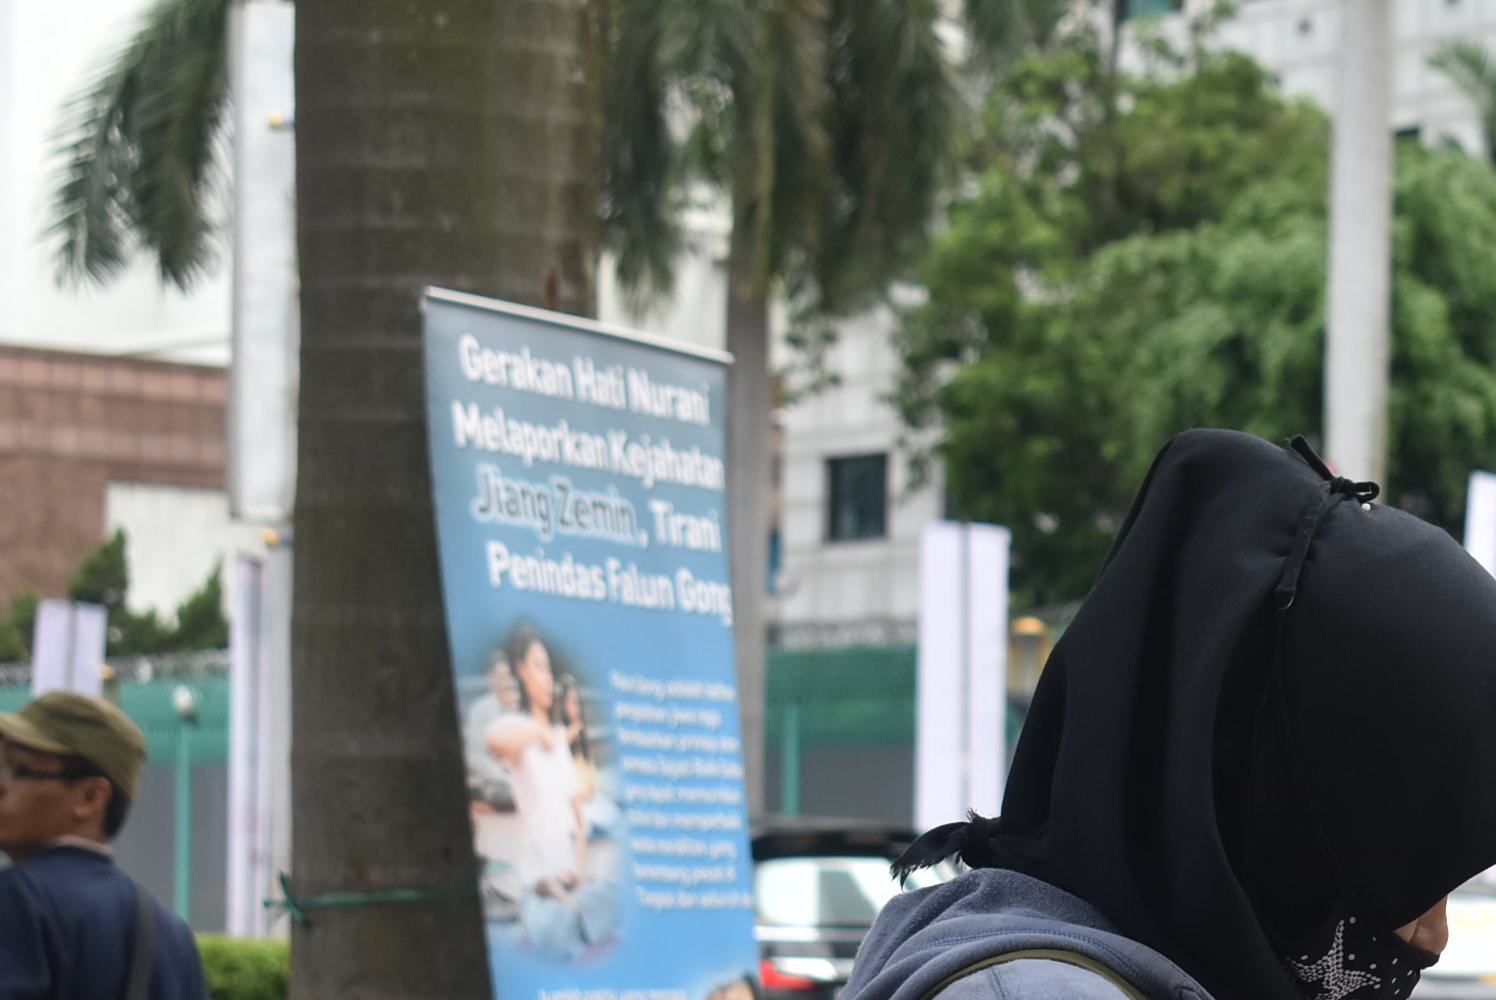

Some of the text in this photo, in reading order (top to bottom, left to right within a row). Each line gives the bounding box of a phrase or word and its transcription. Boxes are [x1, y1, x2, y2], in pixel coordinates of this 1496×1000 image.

[458, 333, 711, 425] Gerakan Hati Nurani
[451, 399, 726, 489] Melaporkan Kejahatan
[470, 463, 554, 541] Jiang
[649, 499, 722, 552] Tirani
[486, 541, 607, 601] Penindas
[606, 557, 676, 610] Falun
